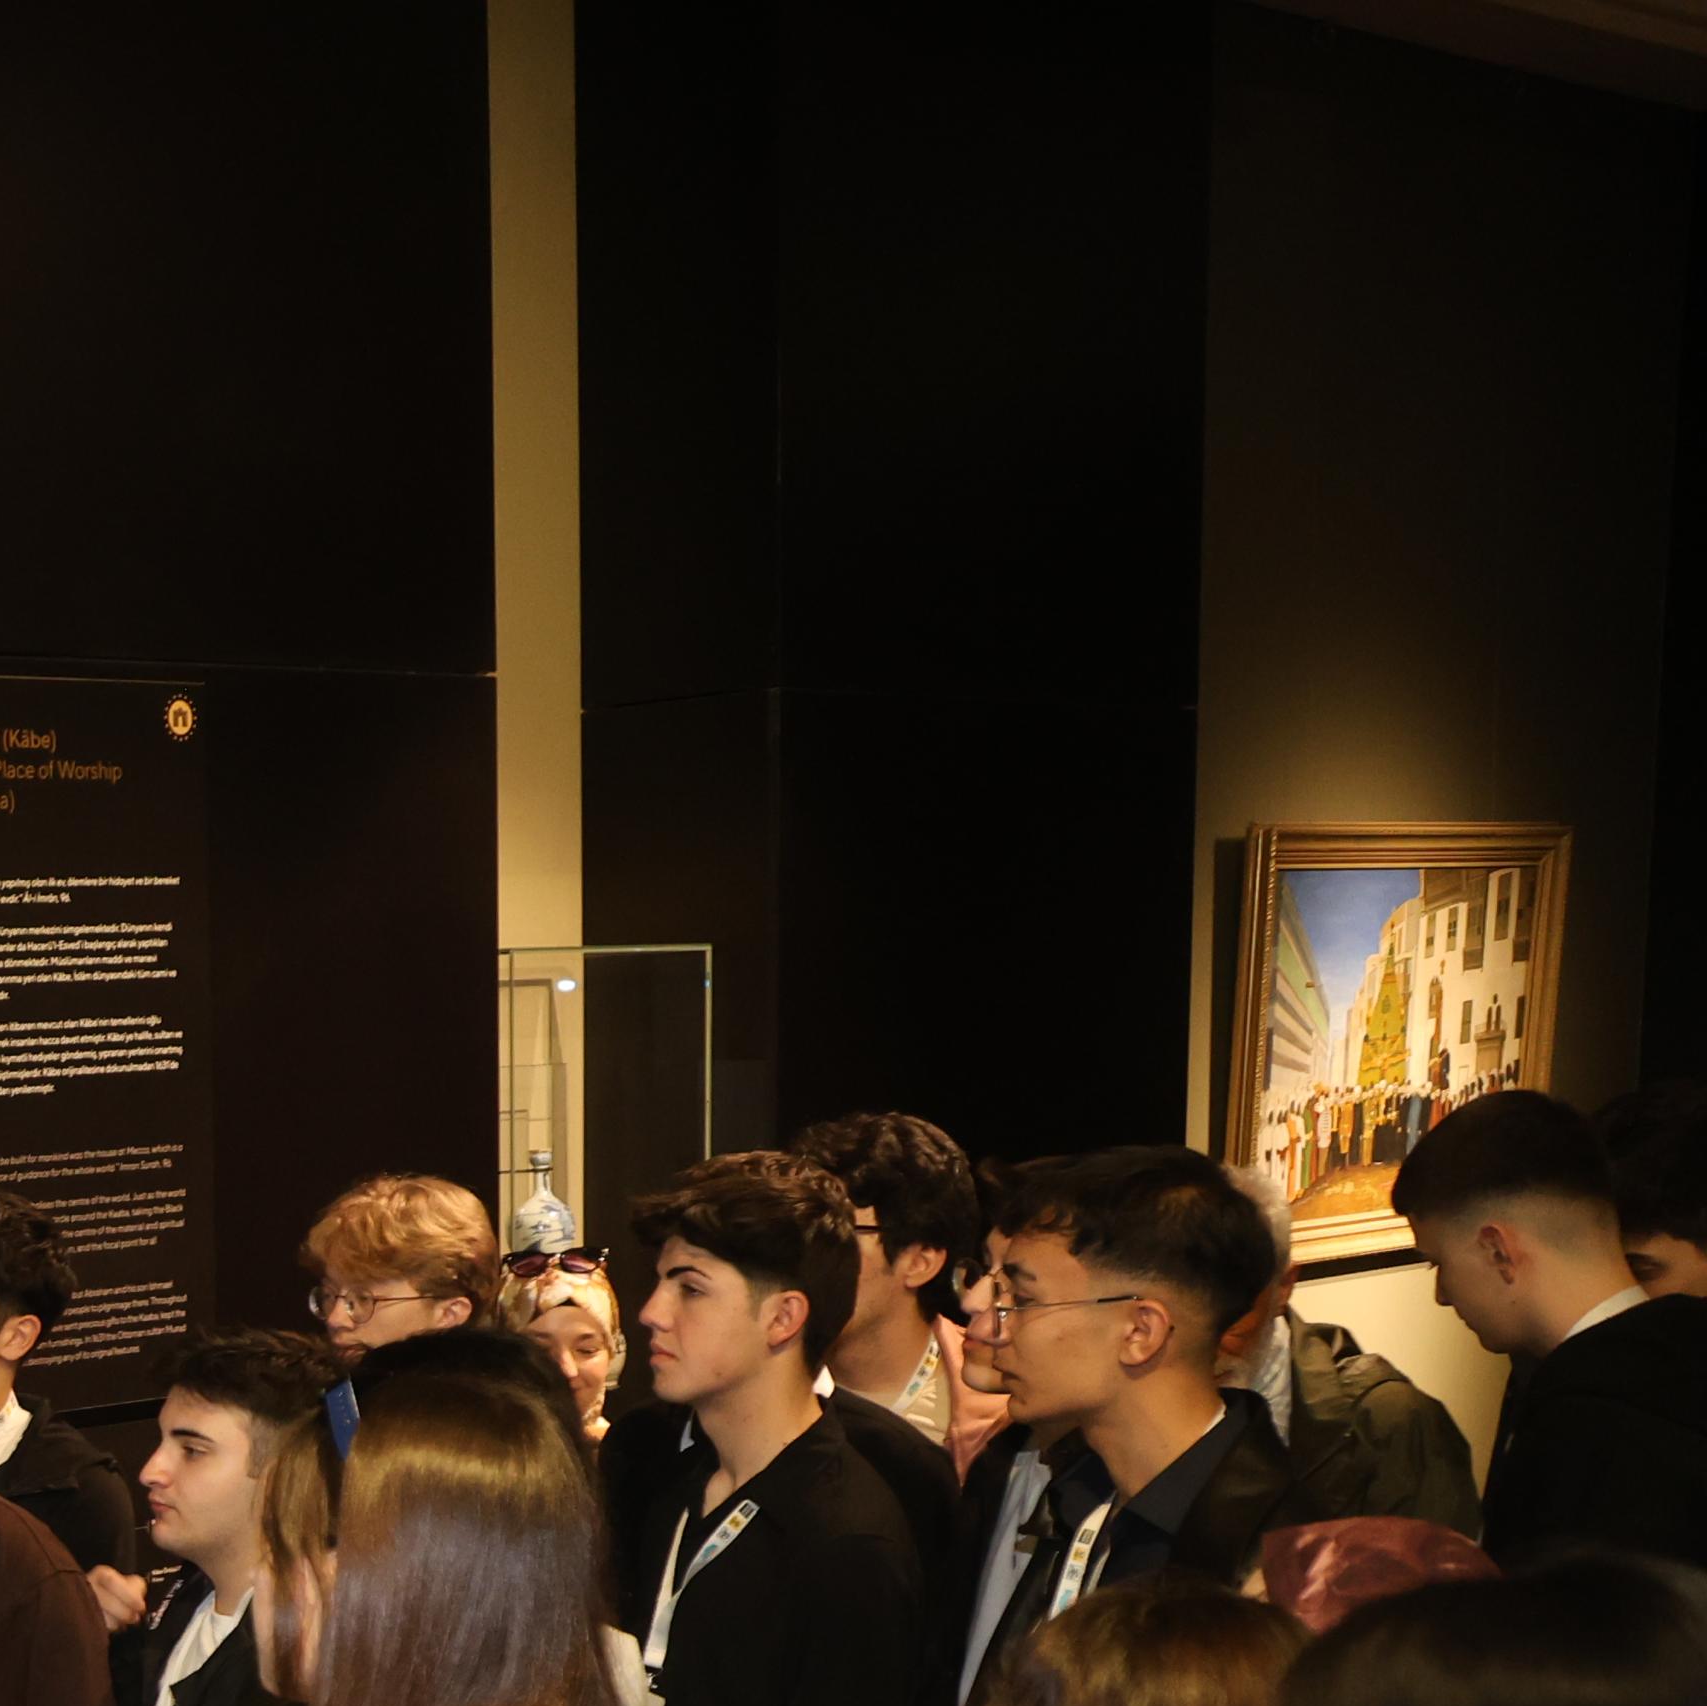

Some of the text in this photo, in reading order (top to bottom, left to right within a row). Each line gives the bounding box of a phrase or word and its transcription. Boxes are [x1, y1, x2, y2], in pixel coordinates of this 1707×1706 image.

[2, 727, 56, 753] (Kâbe)
[39, 762, 55, 779] of
[58, 761, 122, 783] Worship
